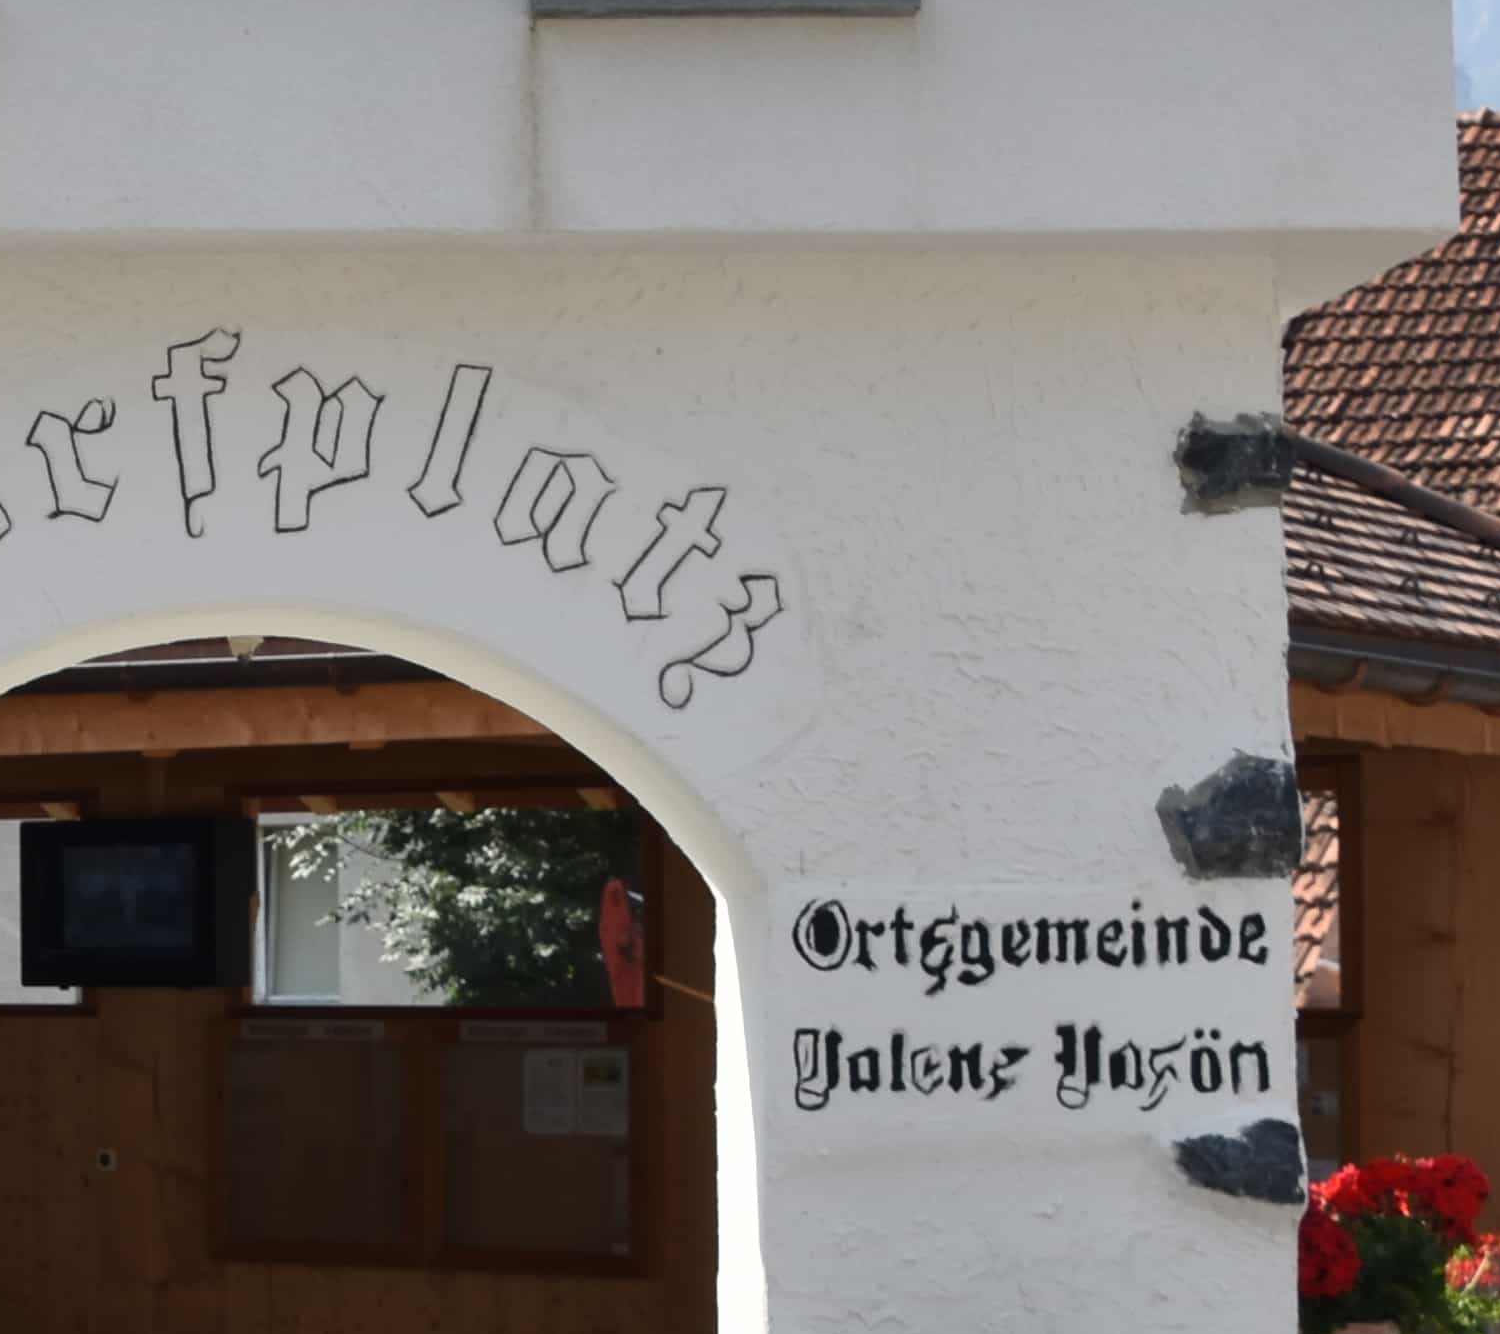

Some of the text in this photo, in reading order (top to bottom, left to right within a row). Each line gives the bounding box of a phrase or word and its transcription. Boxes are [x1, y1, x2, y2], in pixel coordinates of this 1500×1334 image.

[792, 898, 1270, 996] Ortsgemeinde
[794, 1023, 1270, 1111] Valens Vasön
